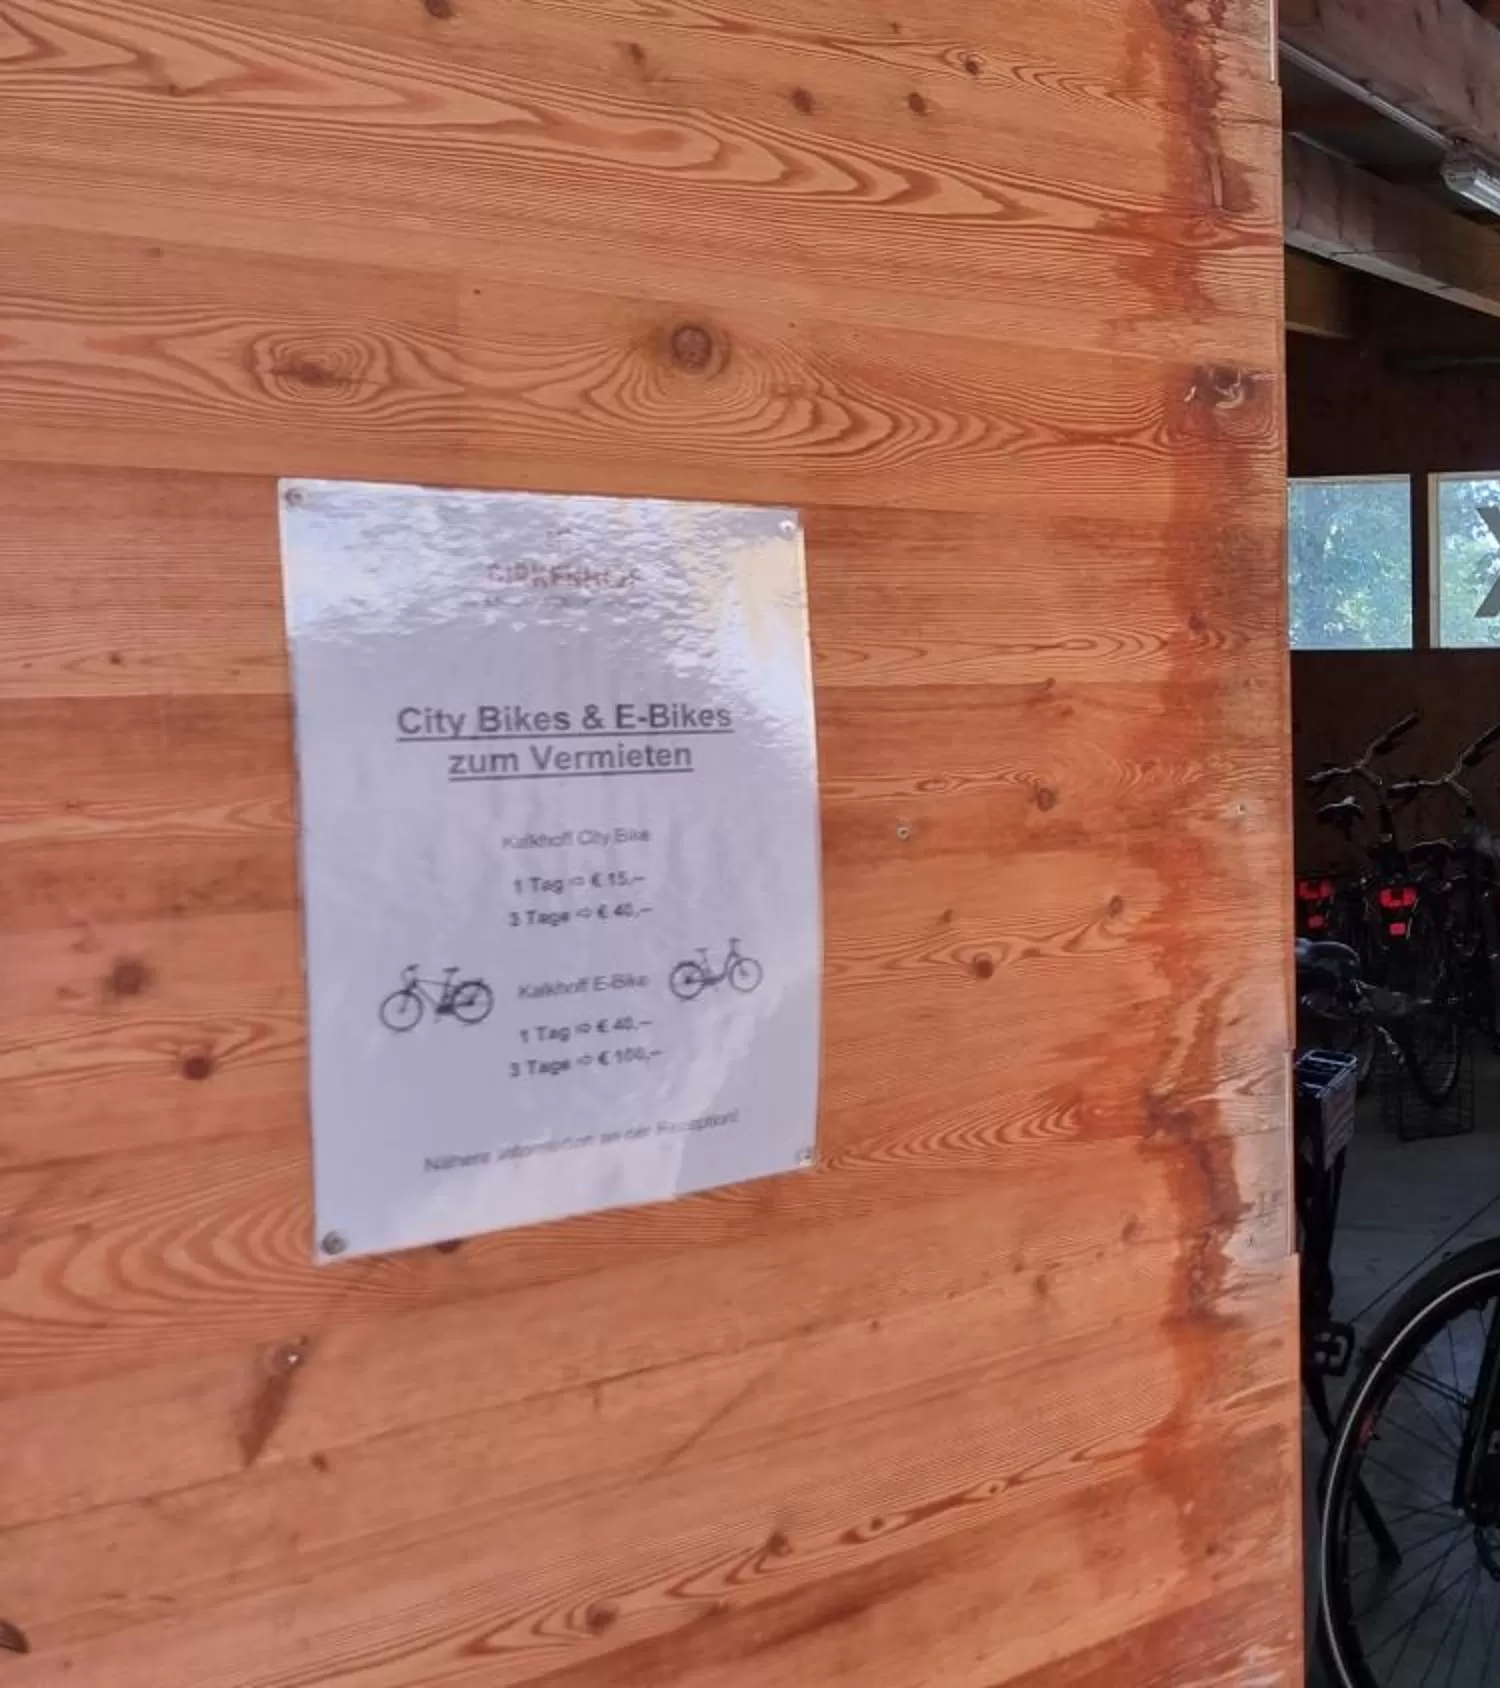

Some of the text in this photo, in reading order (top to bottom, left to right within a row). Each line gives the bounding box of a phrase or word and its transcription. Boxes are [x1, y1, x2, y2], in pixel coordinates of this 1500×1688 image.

[397, 702, 732, 736] City Bikes & E-Bikes
[448, 743, 693, 775] zum Vermieten
[513, 878, 523, 894] 1
[528, 876, 564, 895] Tag
[590, 871, 603, 888] €
[508, 910, 520, 928] 3
[525, 909, 571, 928] Tage
[596, 903, 609, 919] €
[592, 973, 650, 992] E-Bike
[519, 1028, 529, 1044] 1
[535, 1025, 571, 1043] Tag
[596, 1018, 609, 1034] €
[508, 1061, 521, 1078] 3
[526, 1059, 571, 1076] Tage
[598, 1050, 610, 1067] €
